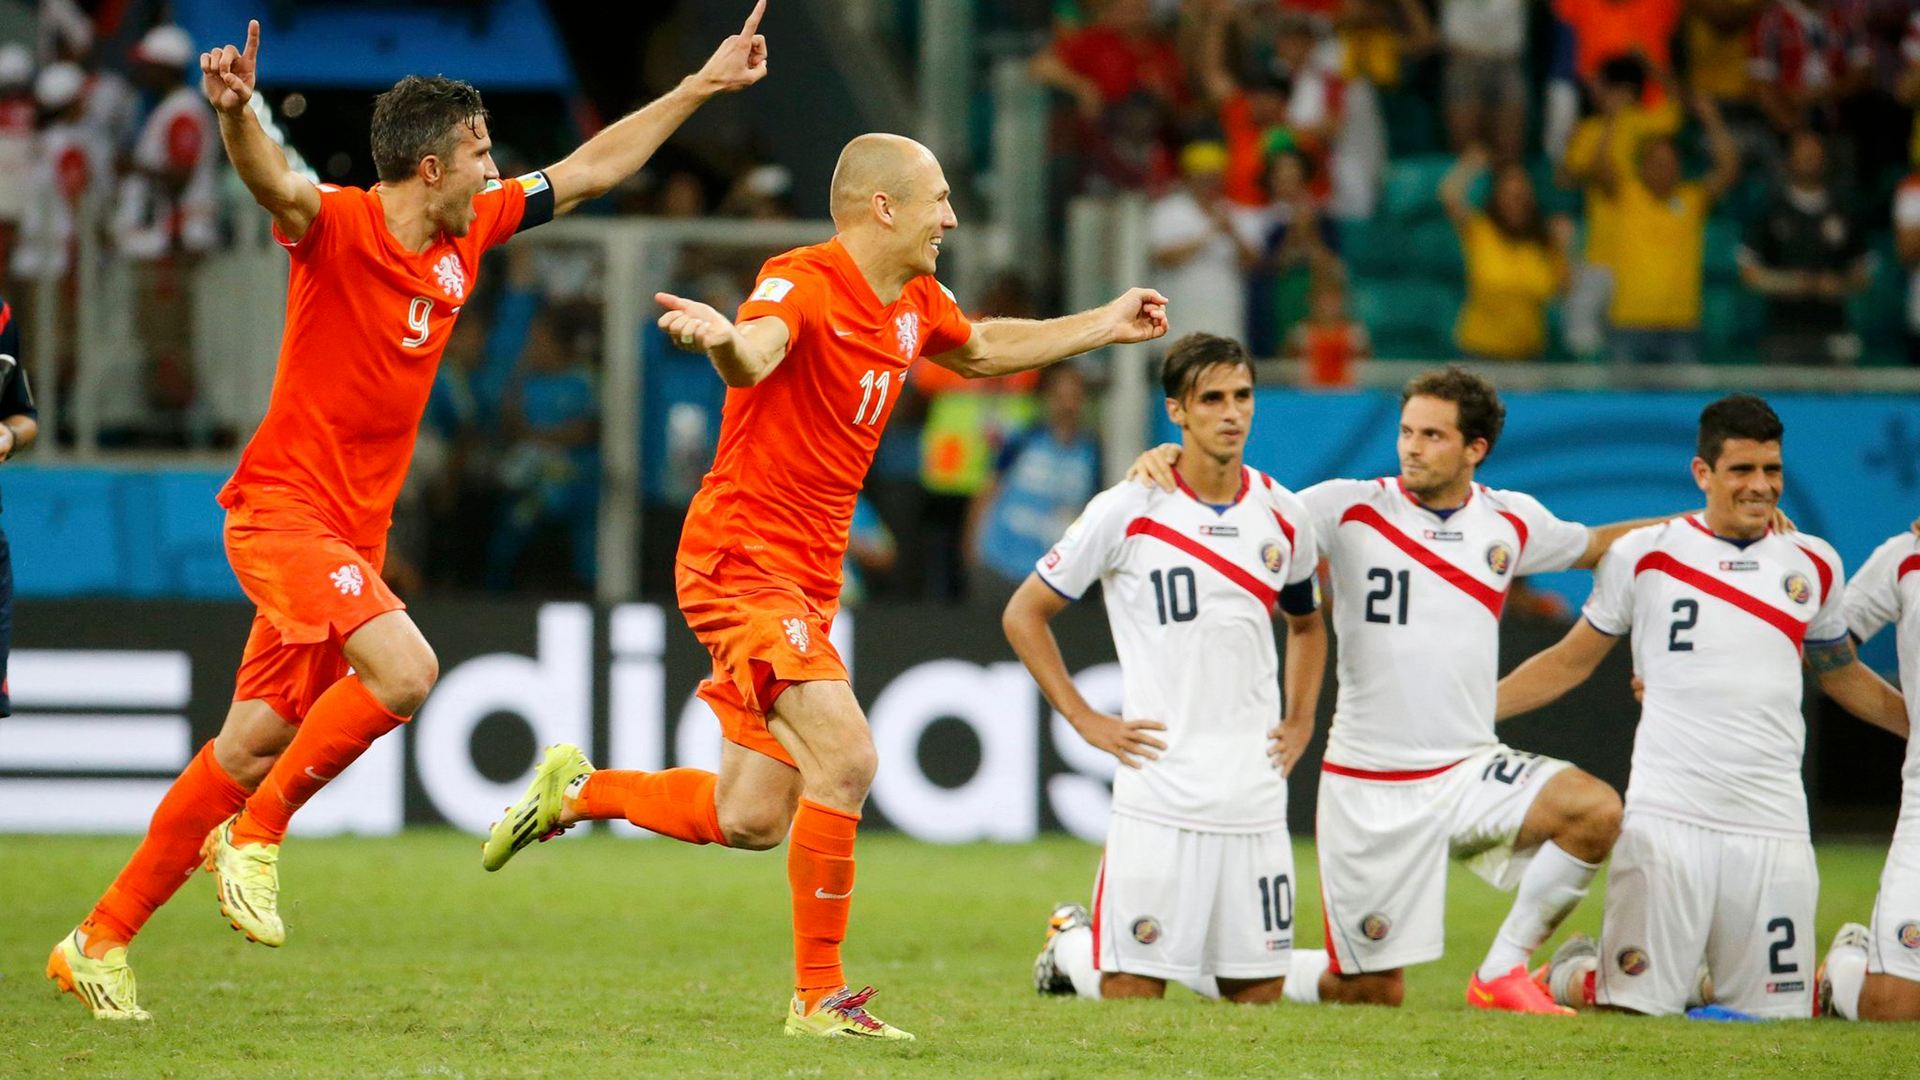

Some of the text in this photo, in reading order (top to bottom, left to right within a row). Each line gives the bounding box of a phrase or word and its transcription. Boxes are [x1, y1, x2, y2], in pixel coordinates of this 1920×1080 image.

[402, 296, 433, 348] 9
[853, 370, 890, 425] 11
[1150, 567, 1197, 625] 10
[1366, 568, 1409, 625] 21
[1669, 599, 1699, 651] 2
[1259, 875, 1292, 931] 10
[1767, 917, 1798, 974] 2
